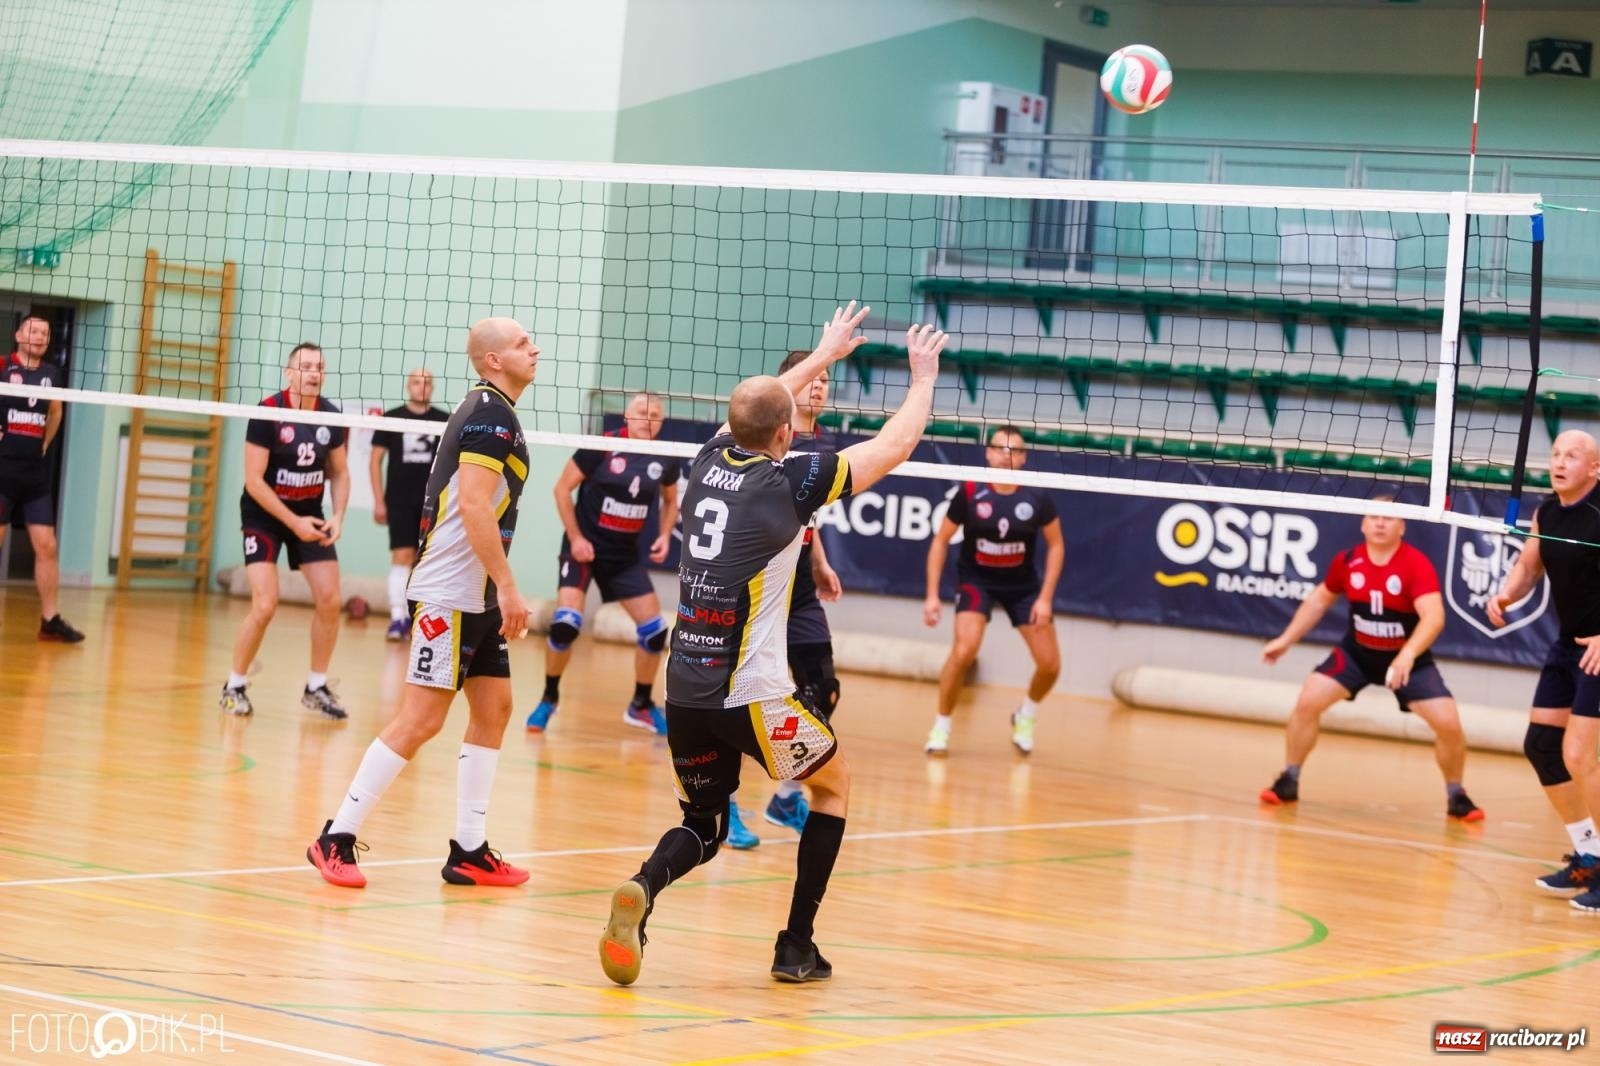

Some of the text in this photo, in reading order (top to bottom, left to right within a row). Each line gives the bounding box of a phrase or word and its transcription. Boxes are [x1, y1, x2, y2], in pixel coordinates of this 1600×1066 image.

[1551, 51, 1584, 73] A
[297, 442, 316, 466] 25
[628, 475, 640, 498] 4
[702, 465, 745, 492] ENTER
[689, 496, 729, 560] 3
[998, 517, 1009, 538] 9
[1369, 589, 1383, 615] 11
[417, 646, 434, 673] 2
[790, 741, 808, 760] 3
